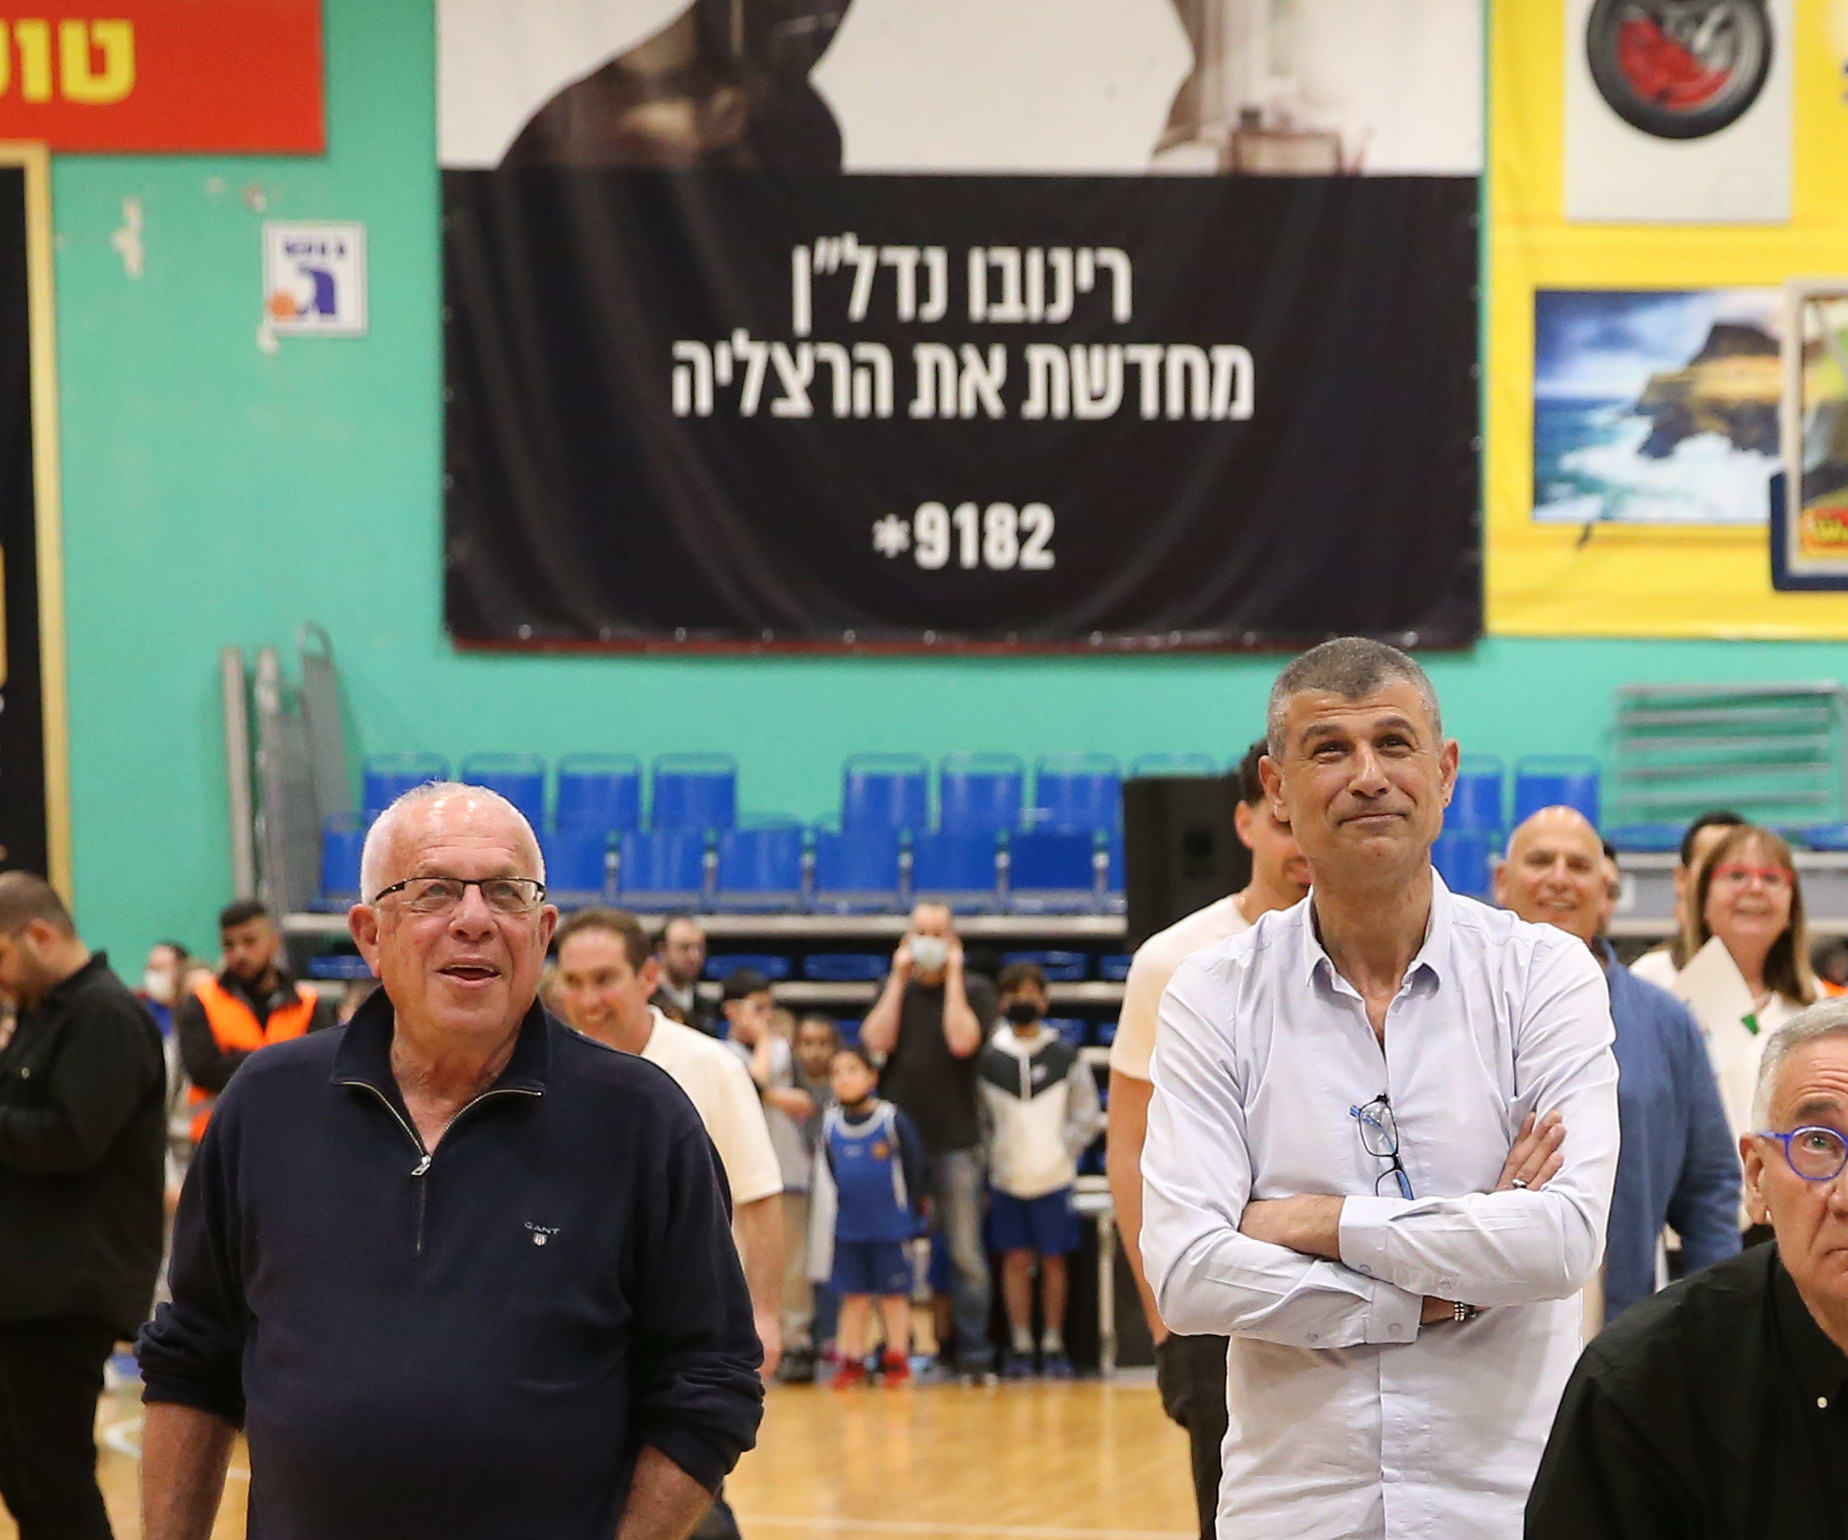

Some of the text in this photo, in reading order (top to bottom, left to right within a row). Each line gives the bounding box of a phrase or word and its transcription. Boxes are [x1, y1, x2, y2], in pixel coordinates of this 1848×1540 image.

[0, 18, 135, 104] טו
[967, 246, 1133, 324] רינובו
[671, 329, 1255, 421] מחדשת את הרצליה
[524, 1221, 560, 1235] GANT
